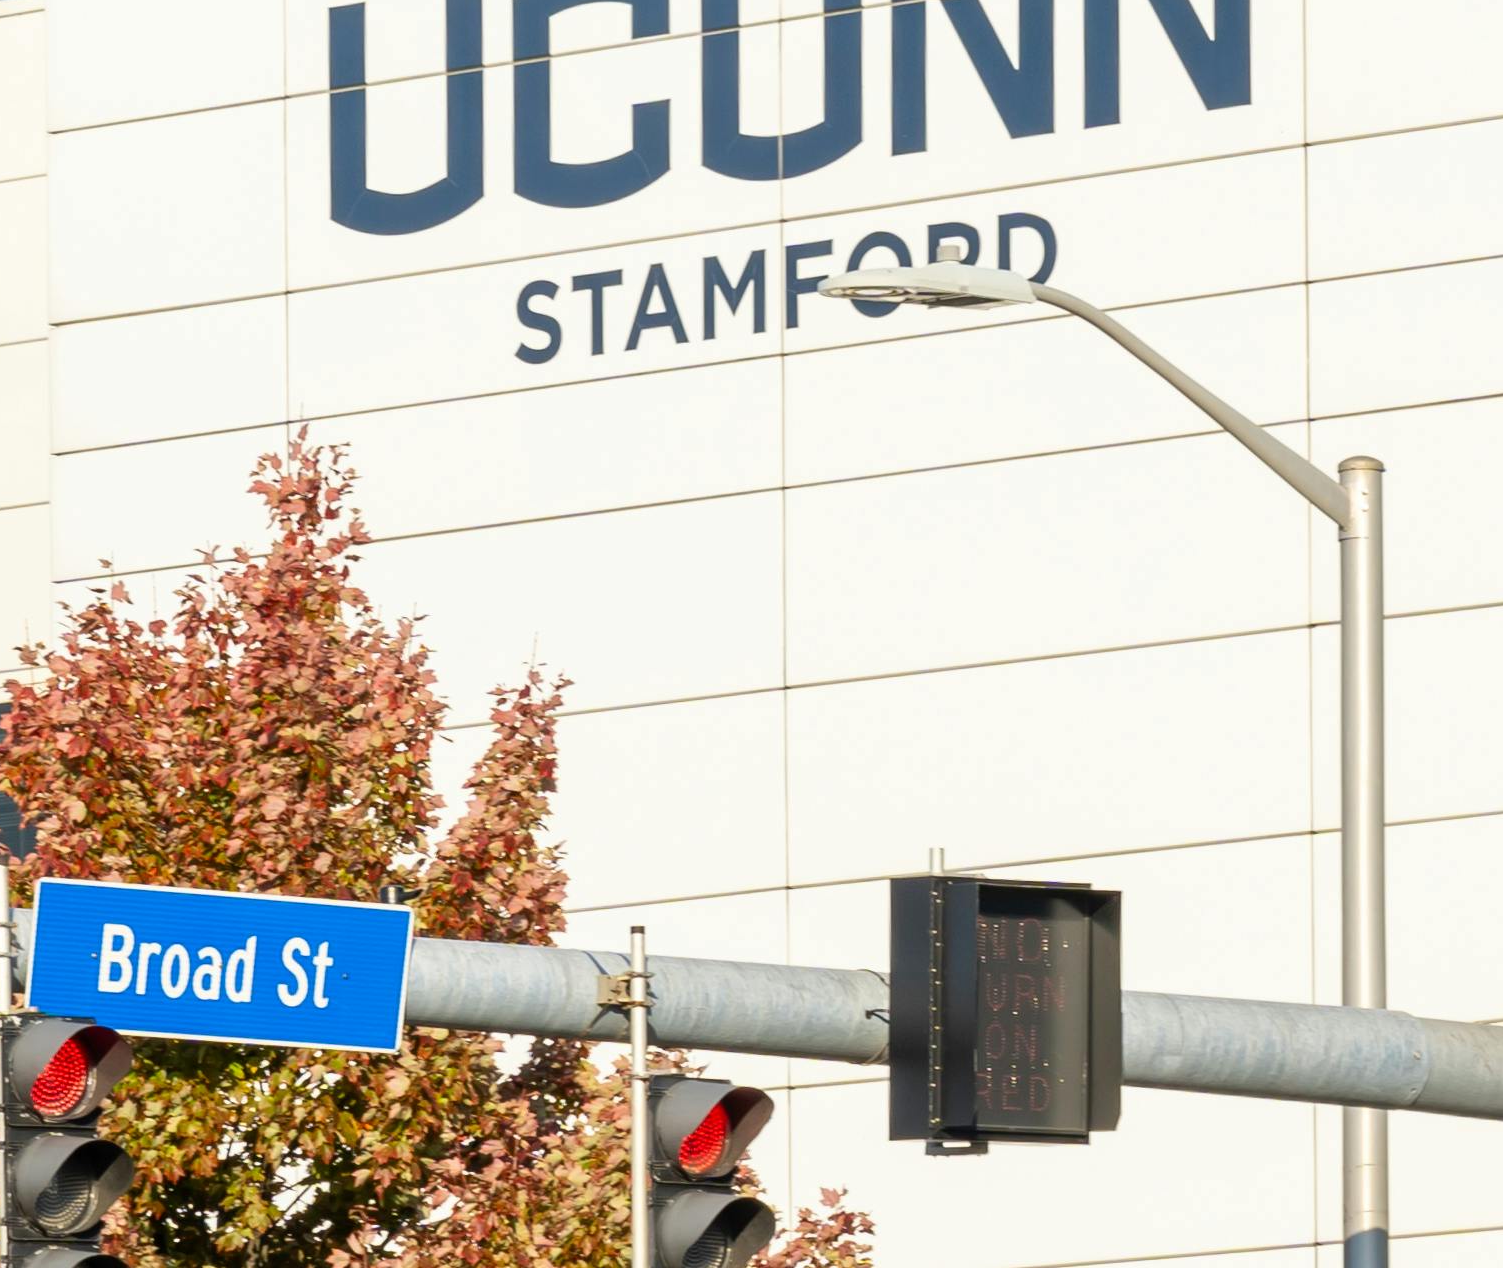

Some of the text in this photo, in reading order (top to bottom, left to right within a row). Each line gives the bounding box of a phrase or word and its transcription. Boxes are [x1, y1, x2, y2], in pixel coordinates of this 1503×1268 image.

[97, 922, 335, 1009] Broad St
[985, 972, 1066, 1016] URN
